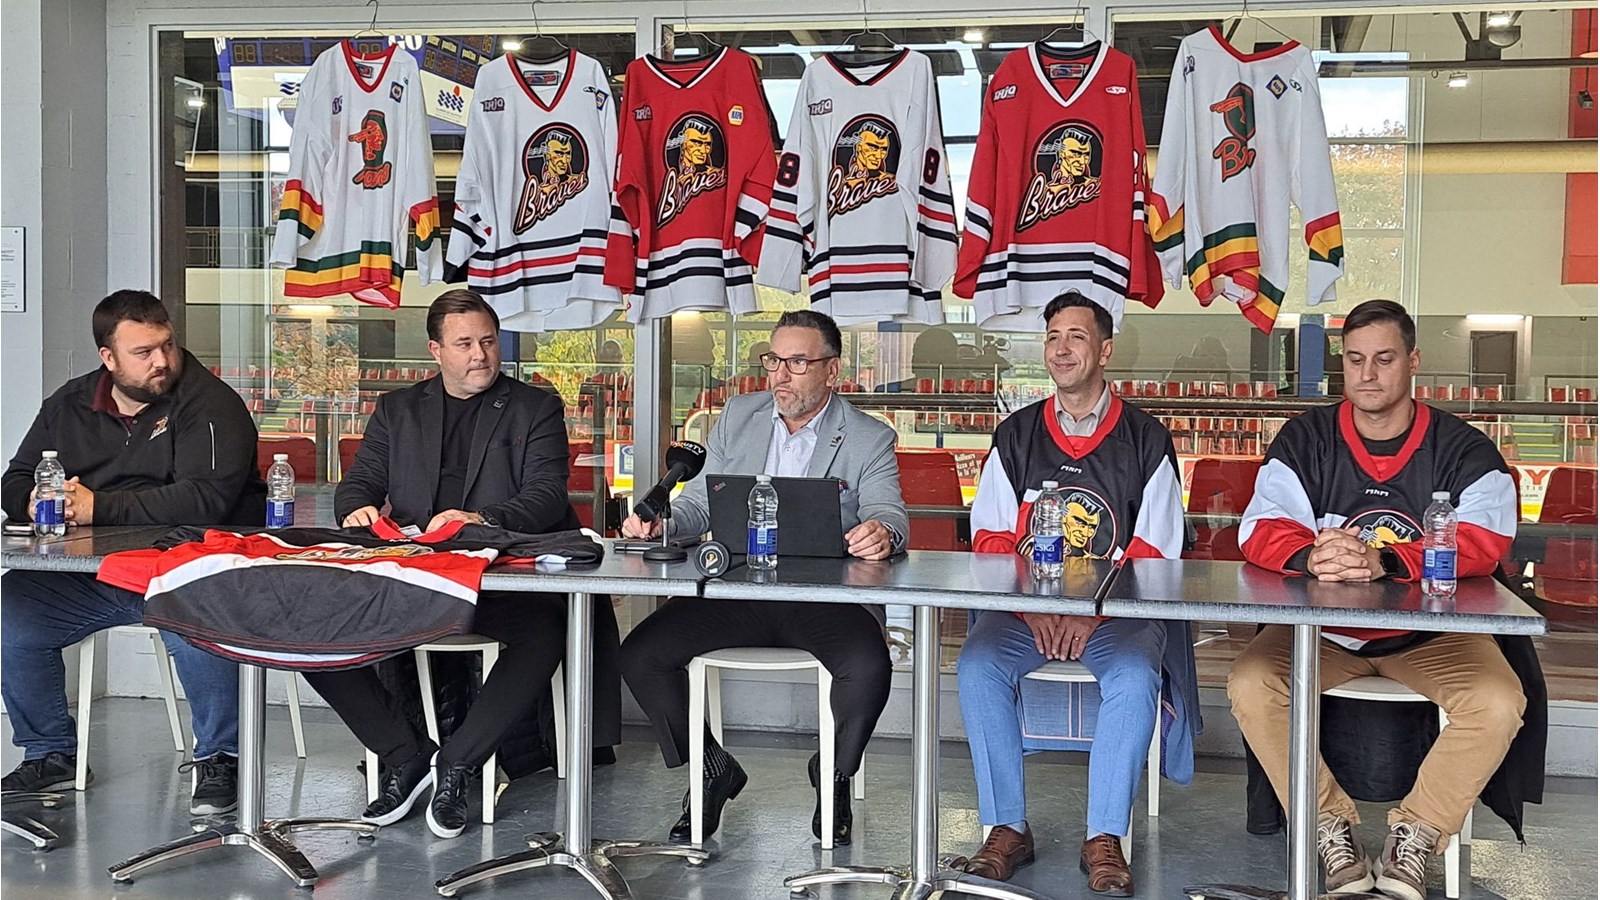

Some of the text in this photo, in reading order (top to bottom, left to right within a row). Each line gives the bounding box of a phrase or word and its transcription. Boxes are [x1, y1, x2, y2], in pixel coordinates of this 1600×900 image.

[776, 152, 800, 188] 8
[849, 166, 869, 180] Les
[923, 148, 940, 185] 8
[1050, 171, 1075, 186] Les
[515, 173, 588, 232] Braves
[828, 168, 899, 213] Braves
[1017, 174, 1101, 229] Braves
